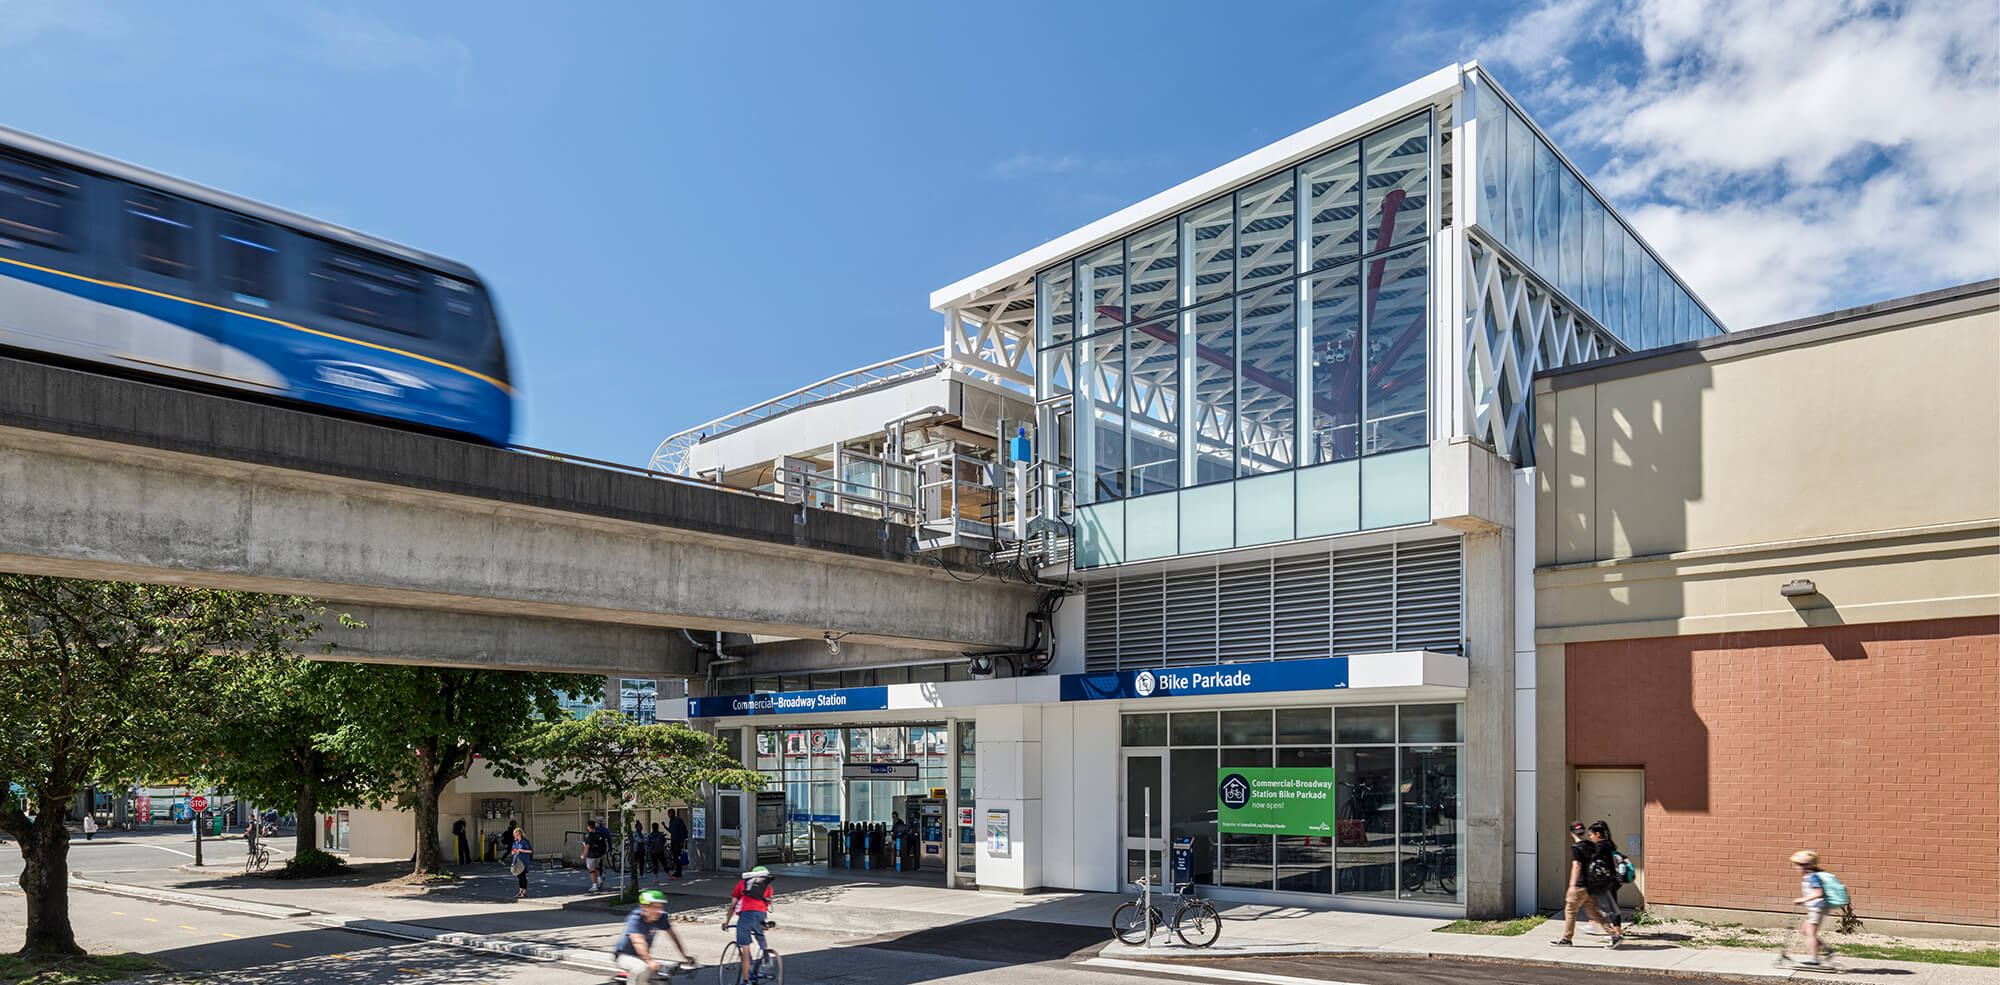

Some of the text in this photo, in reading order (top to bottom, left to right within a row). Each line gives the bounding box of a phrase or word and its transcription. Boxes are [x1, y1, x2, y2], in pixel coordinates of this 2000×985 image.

[1160, 670, 1251, 690] Bike Parkade
[817, 694, 846, 706] Station
[1252, 790, 1327, 799] Station Bike Parkade
